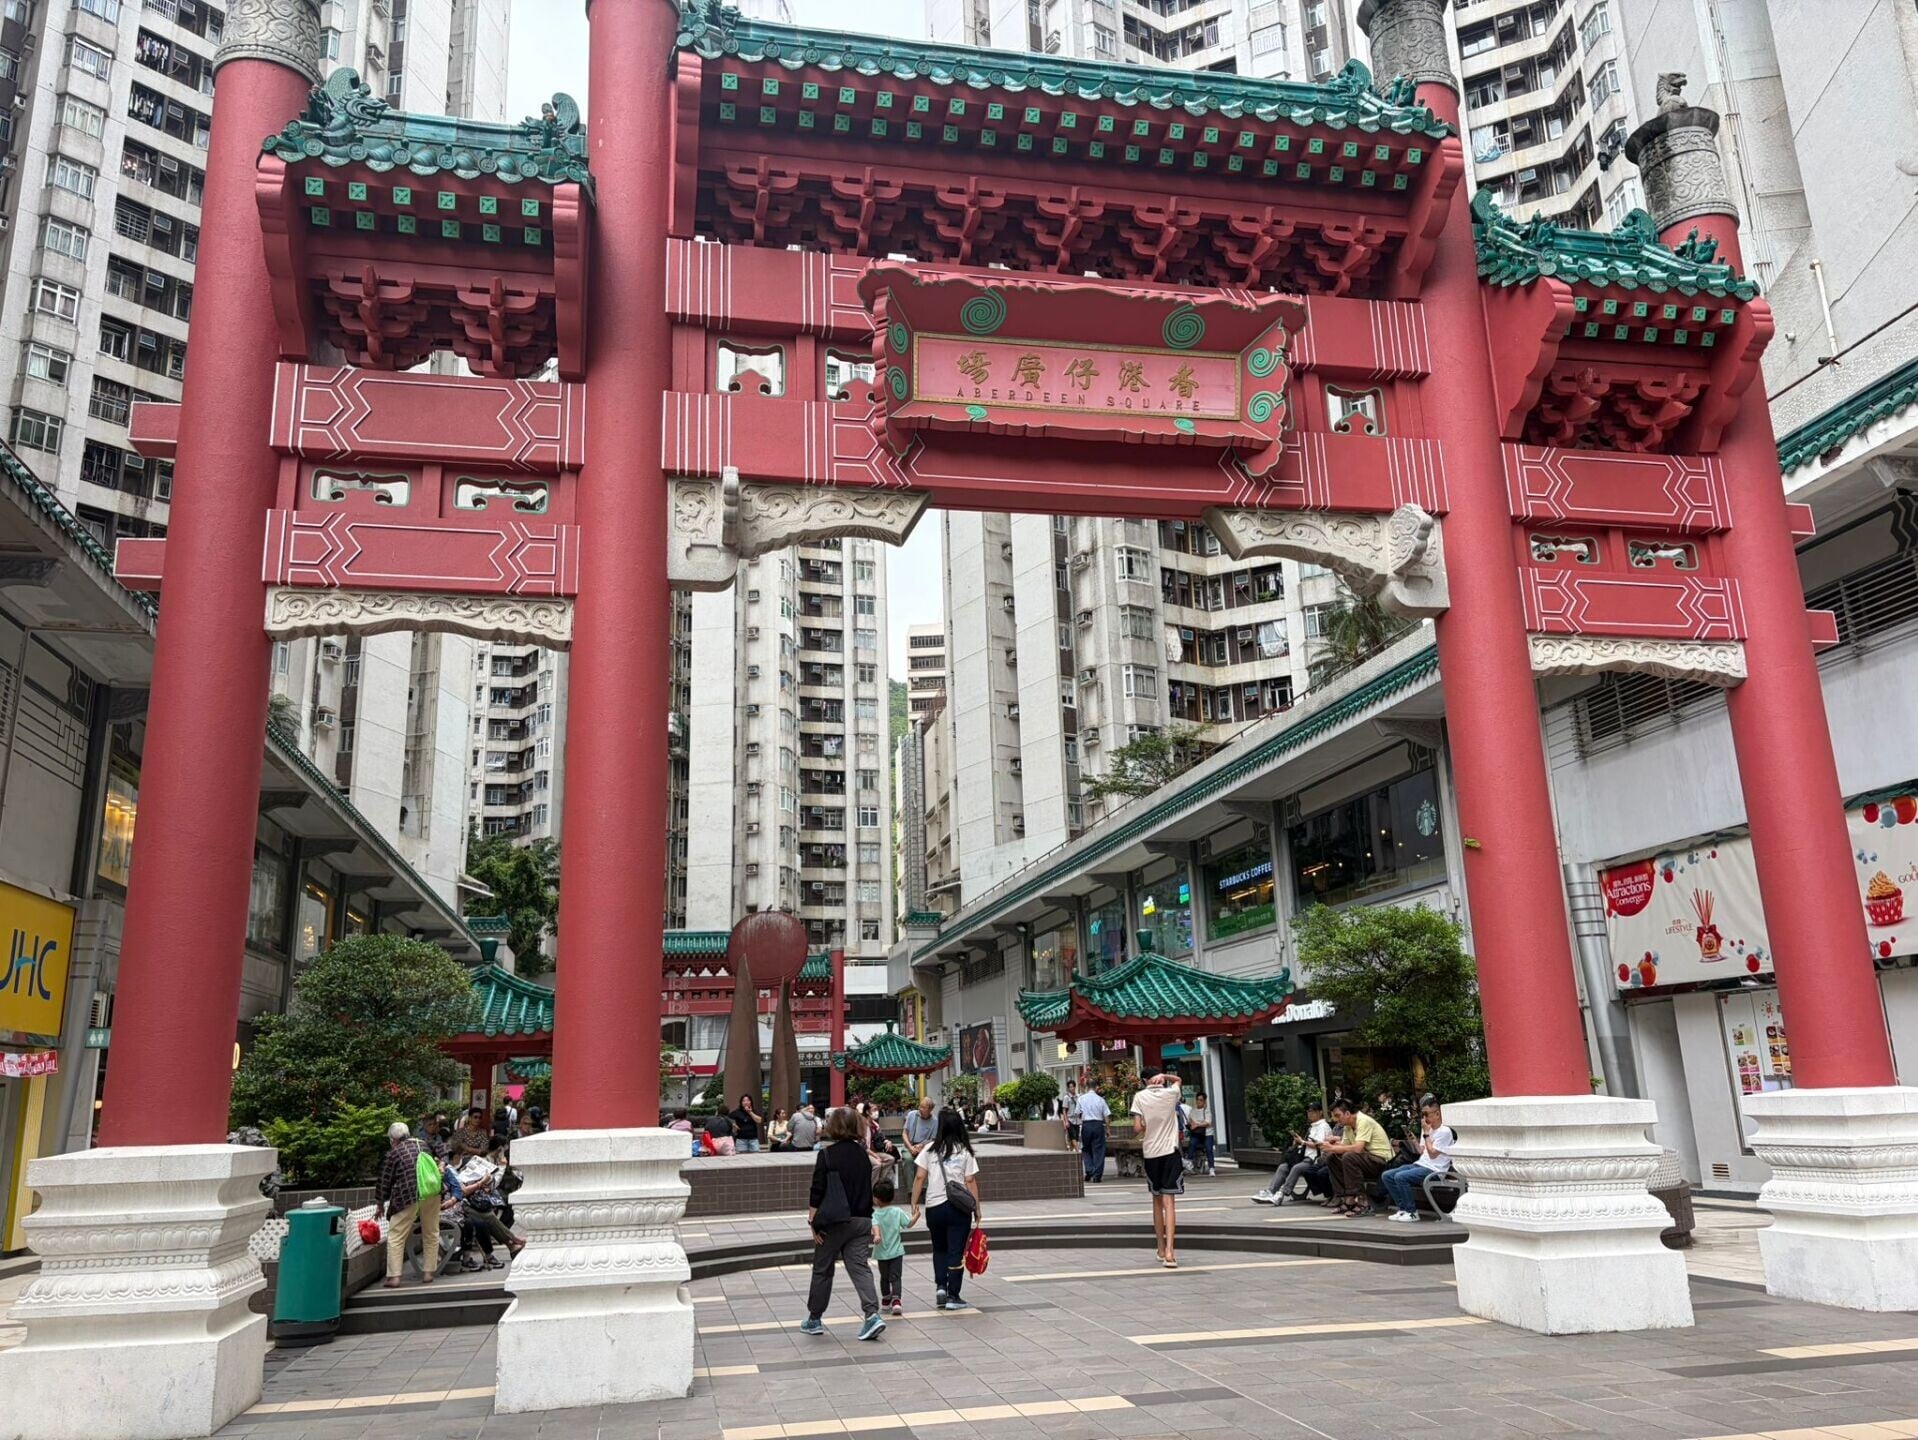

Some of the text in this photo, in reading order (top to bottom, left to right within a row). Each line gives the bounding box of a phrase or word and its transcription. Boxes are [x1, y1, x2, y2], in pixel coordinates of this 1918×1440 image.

[956, 387, 1200, 412] ABERDEEN SQUARE
[1219, 862, 1273, 890] STARBUCKS COFFEE
[1607, 882, 1651, 899] Attractions
[1665, 923, 1694, 936] LIFESTYLE
[0, 929, 57, 1000] JHC
